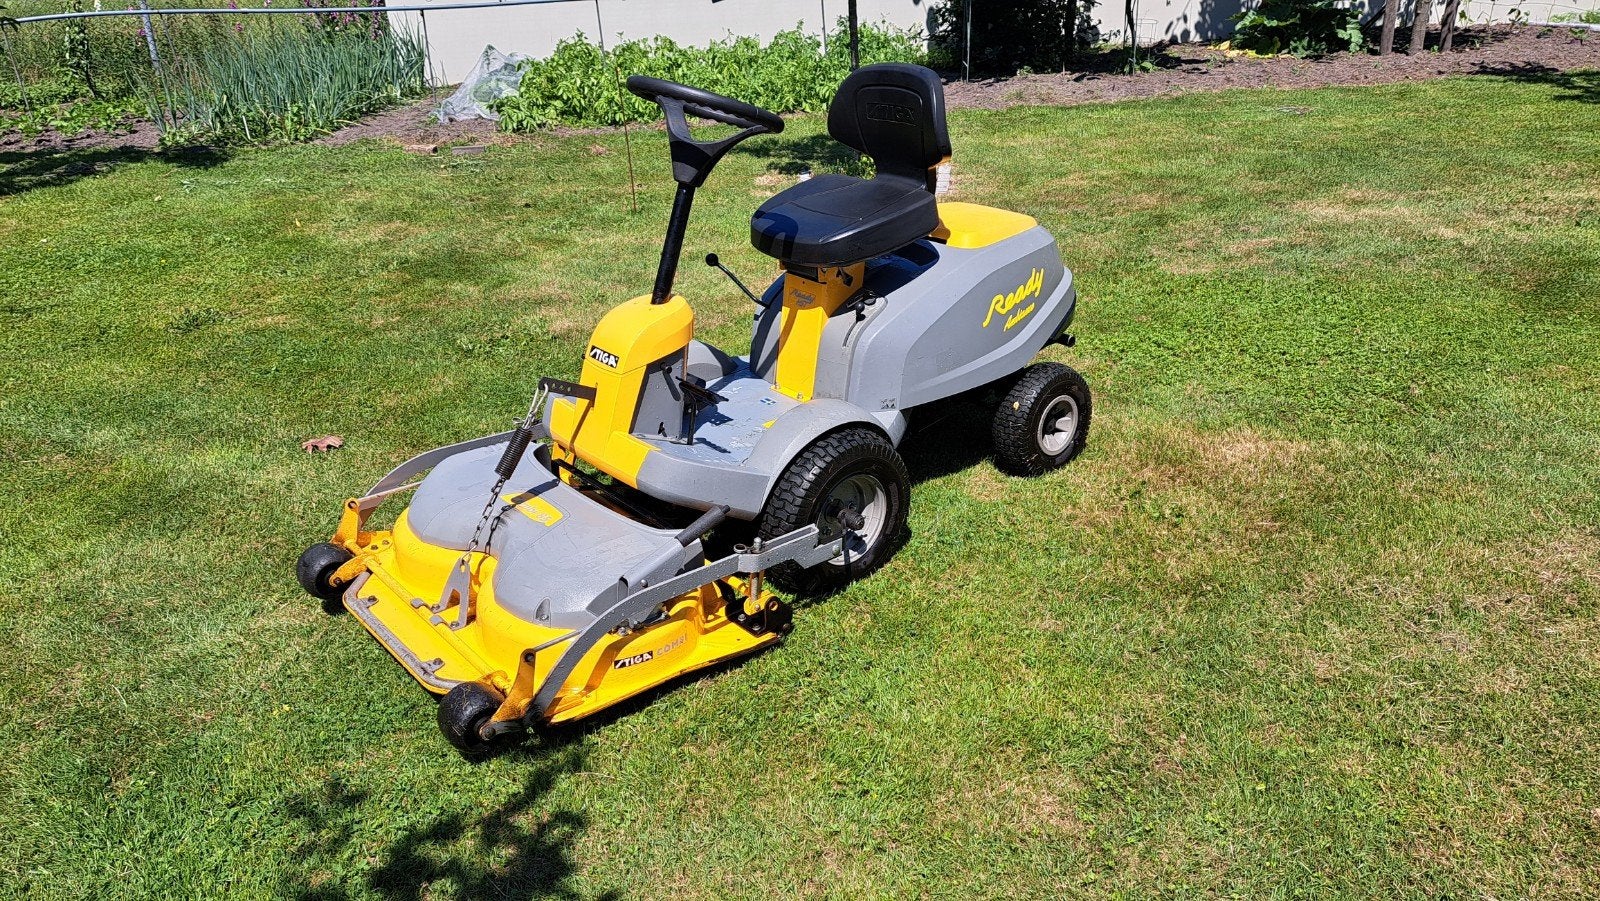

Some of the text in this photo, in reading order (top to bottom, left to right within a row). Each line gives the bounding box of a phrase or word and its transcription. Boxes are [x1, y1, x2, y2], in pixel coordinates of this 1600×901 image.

[982, 267, 1044, 328] Ready
[590, 346, 619, 368] STIGA
[614, 652, 653, 669] STIGA
